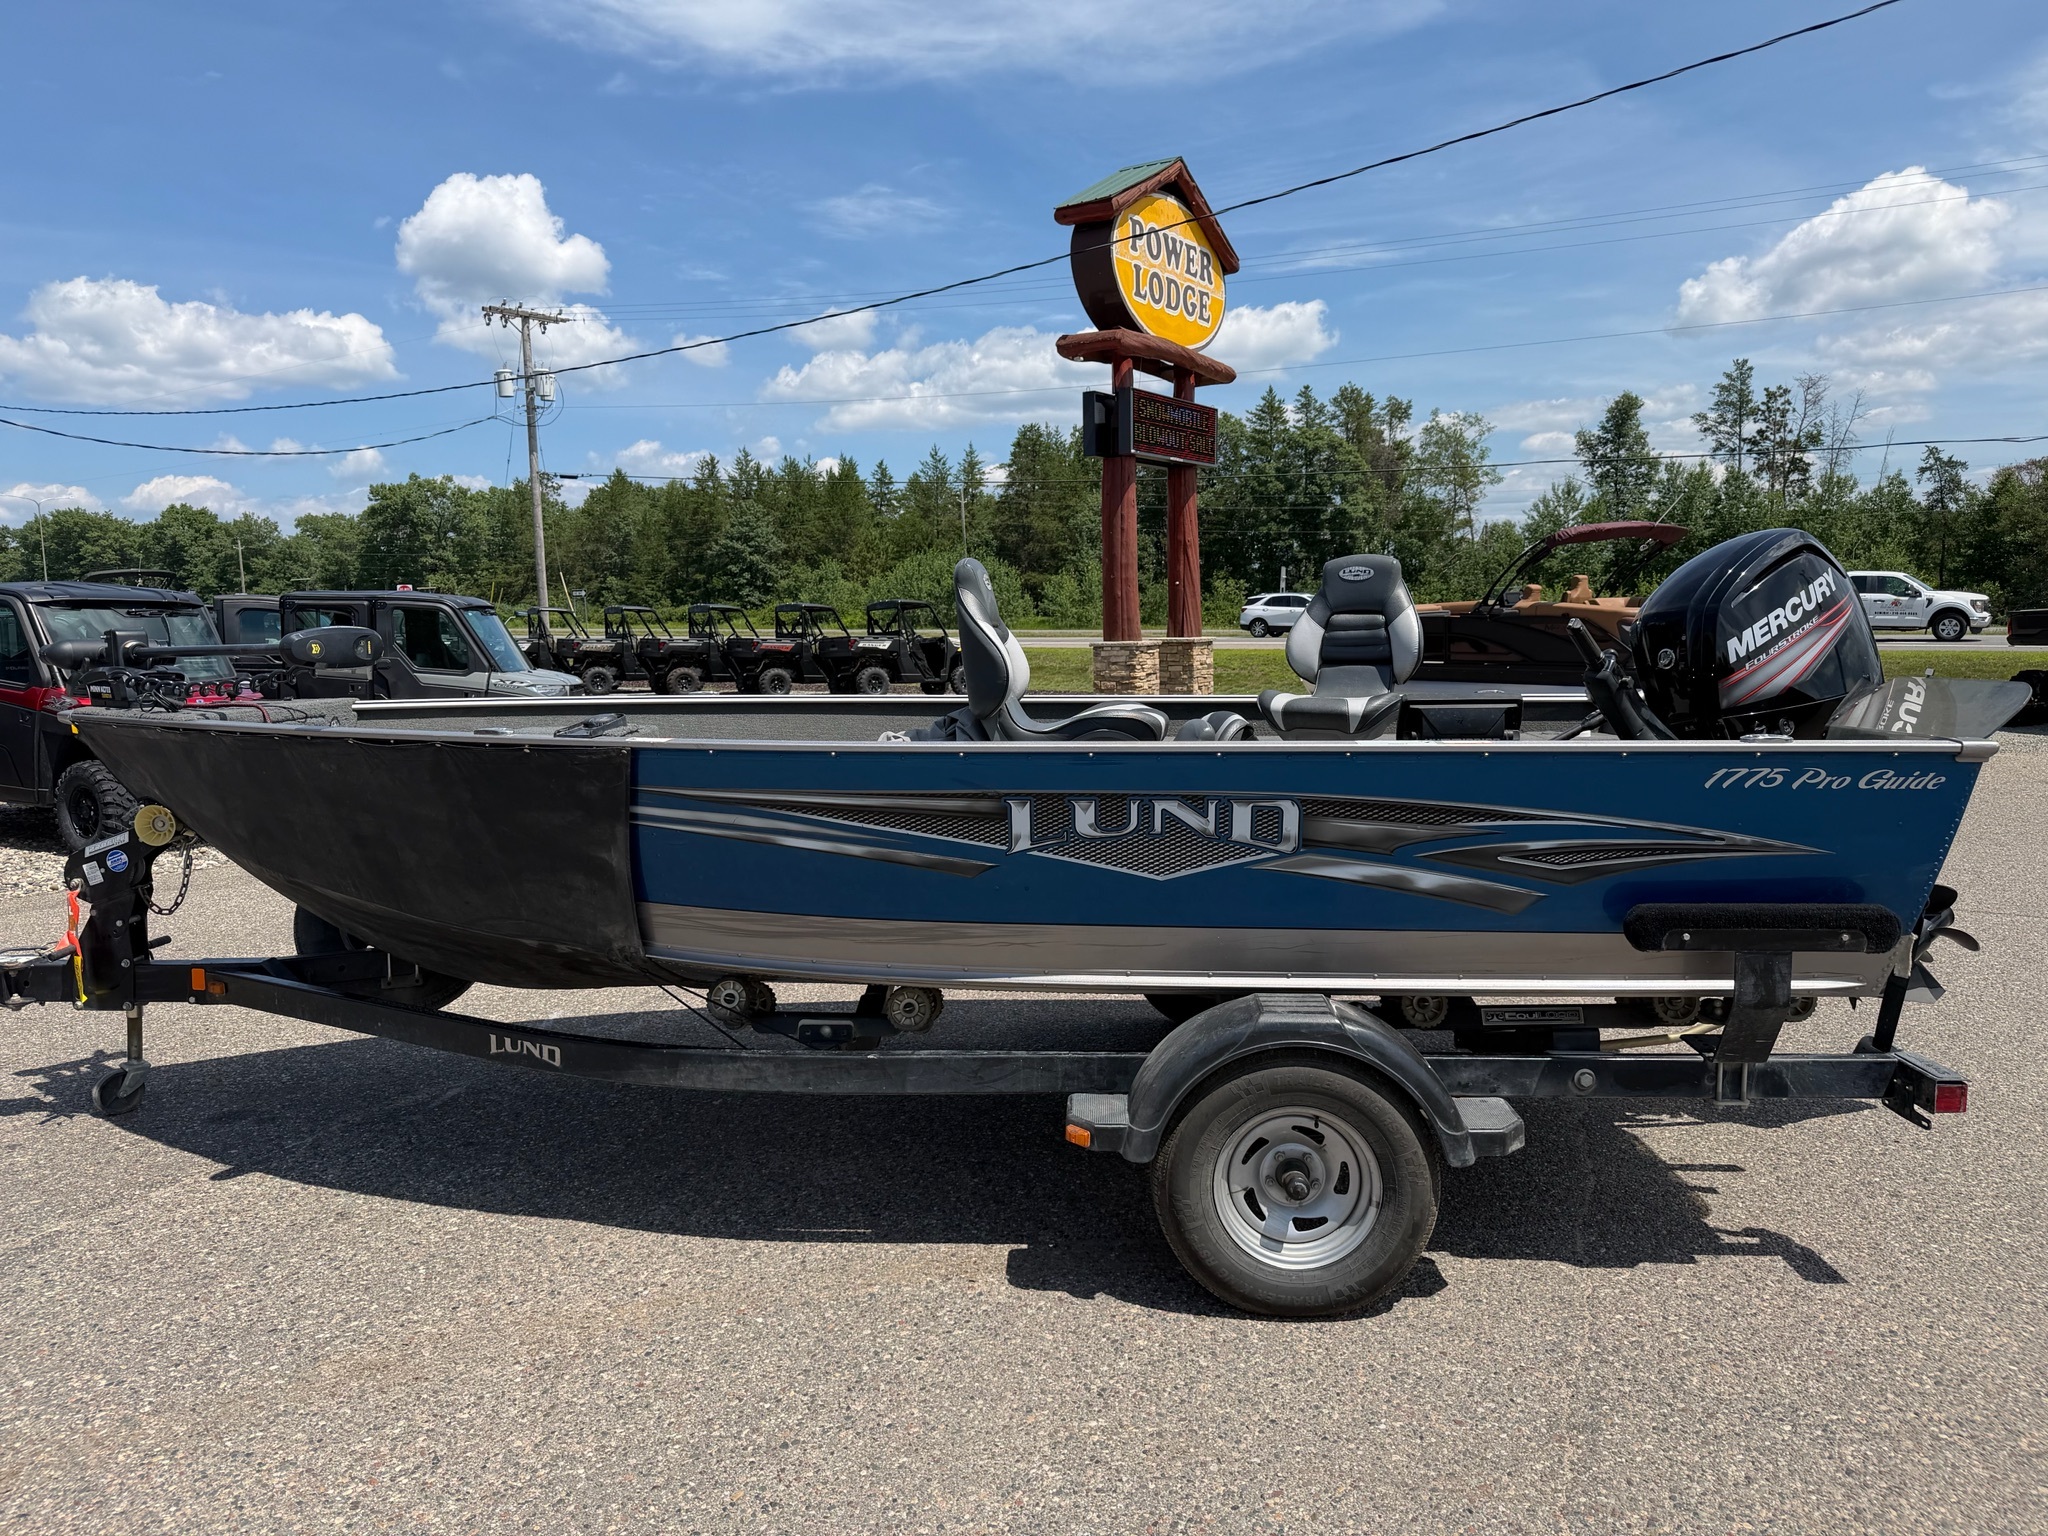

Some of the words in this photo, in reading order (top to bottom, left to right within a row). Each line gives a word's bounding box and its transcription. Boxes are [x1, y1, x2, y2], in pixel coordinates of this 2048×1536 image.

[1129, 216, 1213, 286] POWER
[1133, 262, 1211, 324] LODGE
[1139, 399, 1209, 431] SNOWMOBILE
[1134, 422, 1187, 449] BLOWOUT
[1189, 433, 1214, 454] SALE
[1726, 567, 1837, 664] MERCURY
[1745, 615, 1819, 671] FOURSTROKE
[1704, 768, 1790, 789] 1775
[1792, 767, 1851, 790] Pro
[1858, 769, 1947, 790] Guide
[1005, 800, 1300, 855] LUND
[489, 1033, 561, 1067] LUND
[1274, 1073, 1344, 1092] TRAILER
